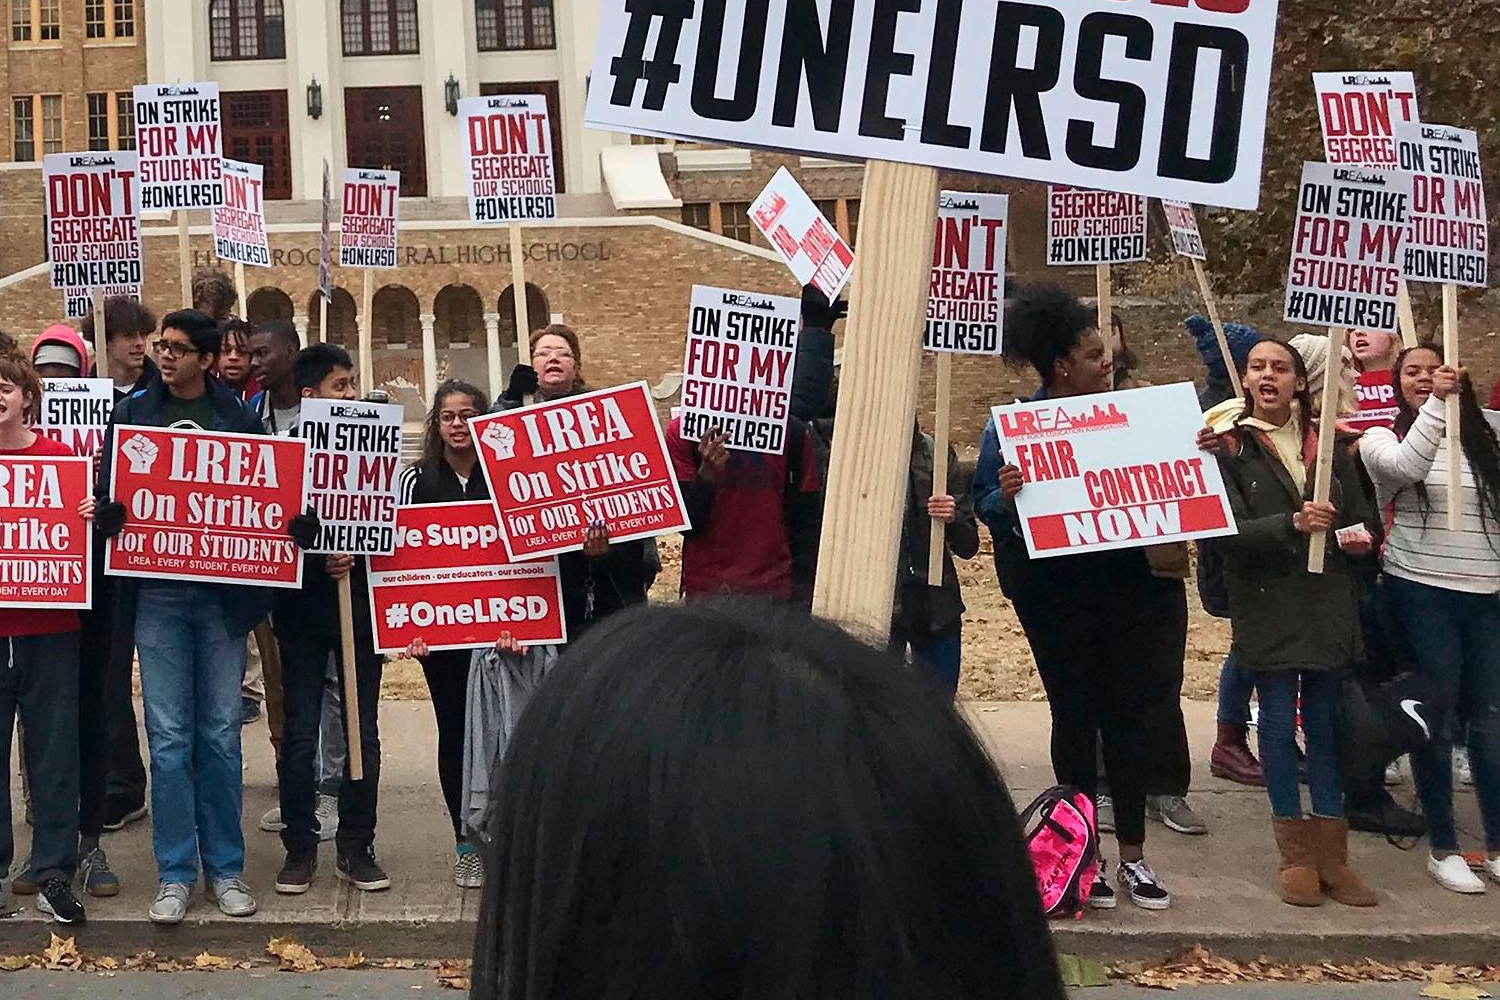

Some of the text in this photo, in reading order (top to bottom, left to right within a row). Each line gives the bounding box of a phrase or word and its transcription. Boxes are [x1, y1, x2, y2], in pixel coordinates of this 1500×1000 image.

[164, 99, 218, 123] STRIKE
[138, 125, 217, 157] FOR MY
[468, 111, 546, 155] DON'T
[1400, 142, 1424, 171] ON
[49, 169, 134, 218] DON'T
[344, 183, 397, 216] DON'T
[473, 180, 552, 196] OUR SCHOOLS
[476, 197, 555, 219] #ONELRSD
[1337, 188, 1407, 222] STRIKE
[51, 217, 136, 244] SEGREGATE
[232, 227, 265, 245] SCHOOLS
[342, 217, 395, 235] SEGREGATE
[342, 234, 395, 247] OUR SCHOOLS
[1052, 217, 1143, 237] OUR SCHOOLS
[1296, 216, 1402, 263] FOR MY
[53, 242, 138, 262] OUR SCHOOLS
[342, 247, 394, 266] #ONELRSD
[456, 245, 512, 264] HIGH
[1051, 235, 1143, 262] #ONELRSD
[1292, 258, 1398, 296] STUDENTS
[1288, 291, 1395, 329] #ONELRSD
[692, 306, 796, 348] ON STRIKE
[688, 338, 791, 388] FOR MY
[685, 380, 788, 419] STUDENTS
[521, 398, 633, 458] LREA
[1000, 406, 1073, 436] LREA
[336, 424, 399, 453] STRIKE
[168, 437, 279, 489] LREA
[508, 452, 650, 503] On Strike
[1016, 440, 1080, 483] FAIR
[1084, 458, 1207, 508] CONTRACT
[132, 488, 283, 530] On Strike
[508, 485, 674, 537] for OUR STUDENTS
[1063, 501, 1181, 546] NOW
[552, 513, 664, 542] EVERY EVERY DAY
[153, 532, 294, 564] OUR STUDENTS
[129, 556, 150, 566] LREA
[157, 559, 184, 569] EVERY
[231, 563, 259, 573] EVERY
[261, 565, 279, 575] DAY
[383, 575, 397, 583] our
[398, 573, 431, 582] children
[452, 570, 492, 579] educators
[498, 569, 512, 577] our
[513, 567, 544, 575] schools
[22, 587, 49, 596] EVERY
[51, 587, 68, 596] DAY
[386, 596, 549, 628] #OneLRSD
